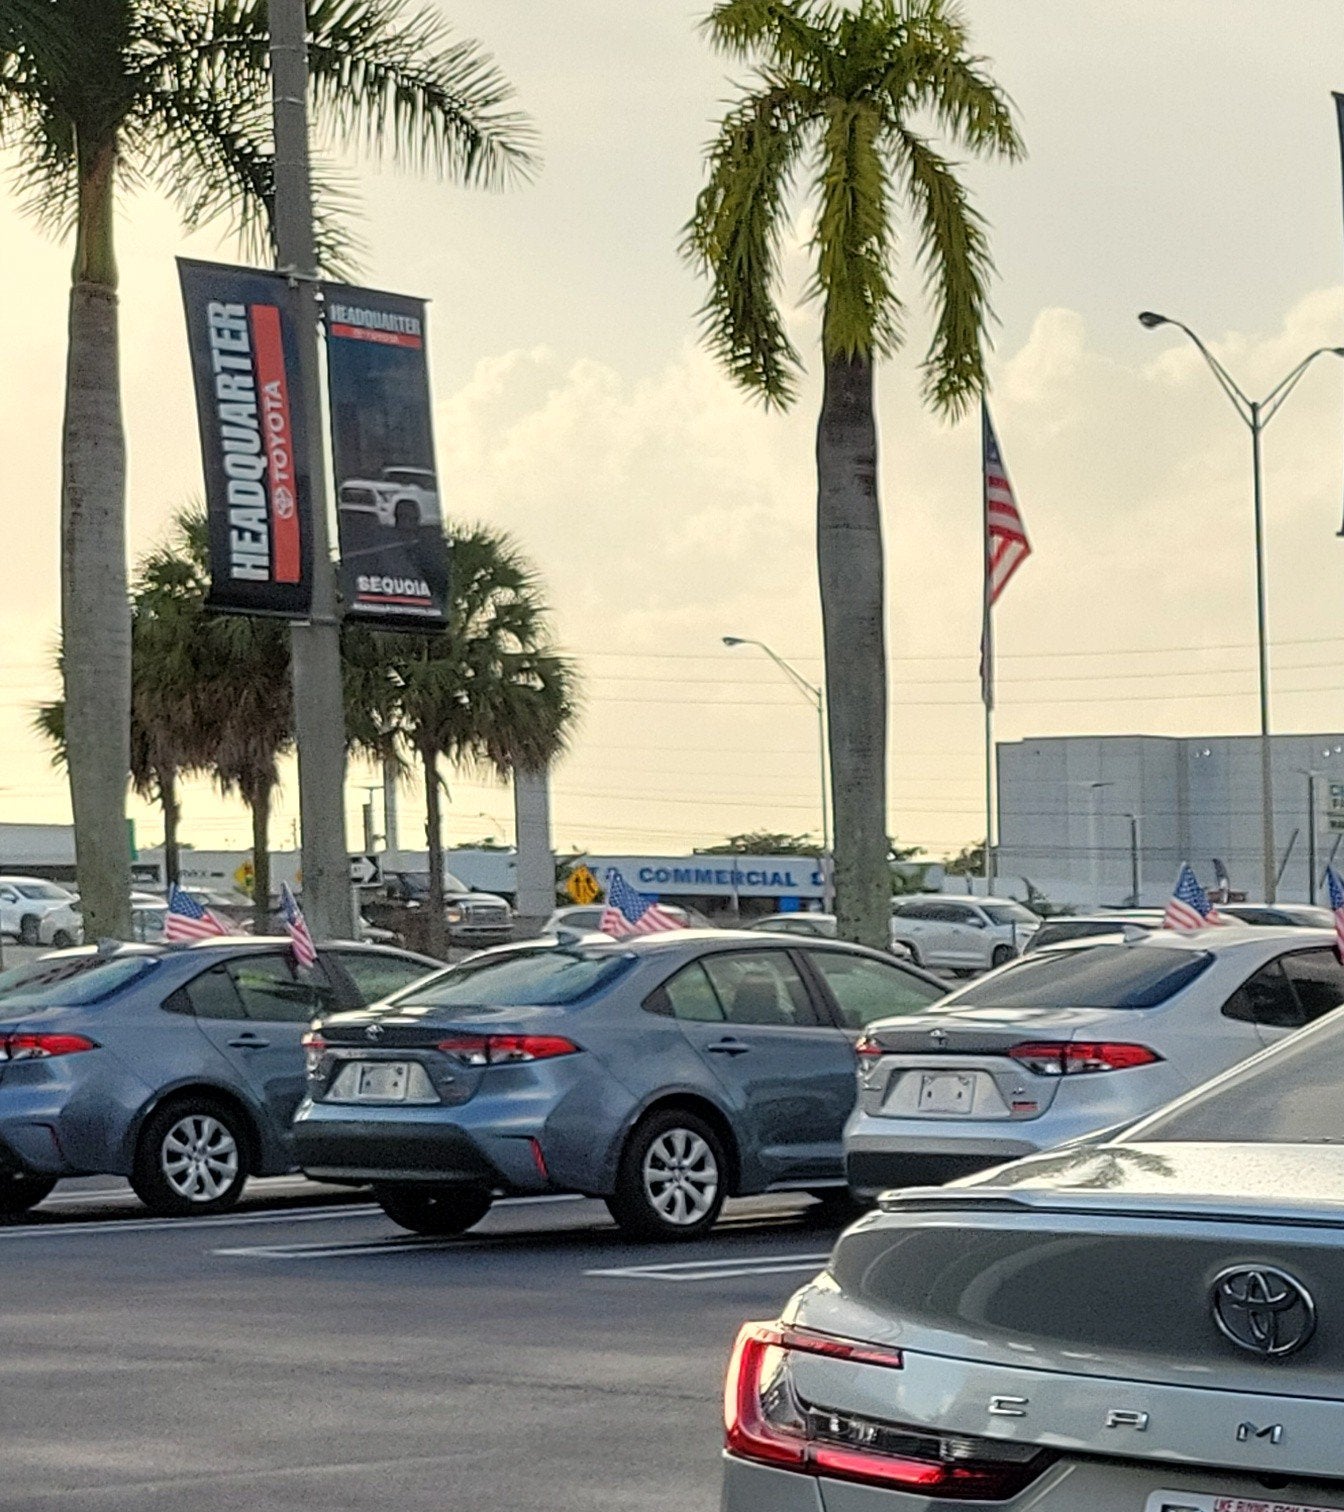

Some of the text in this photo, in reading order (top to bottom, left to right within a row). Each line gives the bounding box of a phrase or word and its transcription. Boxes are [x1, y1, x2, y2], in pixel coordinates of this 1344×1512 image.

[330, 303, 421, 336] HEADQUARTER
[208, 302, 269, 581] HEADQUARTER
[263, 380, 290, 482] TOYOTA
[357, 575, 431, 597] SEQUOIA
[639, 867, 798, 887] COMMERCIAL
